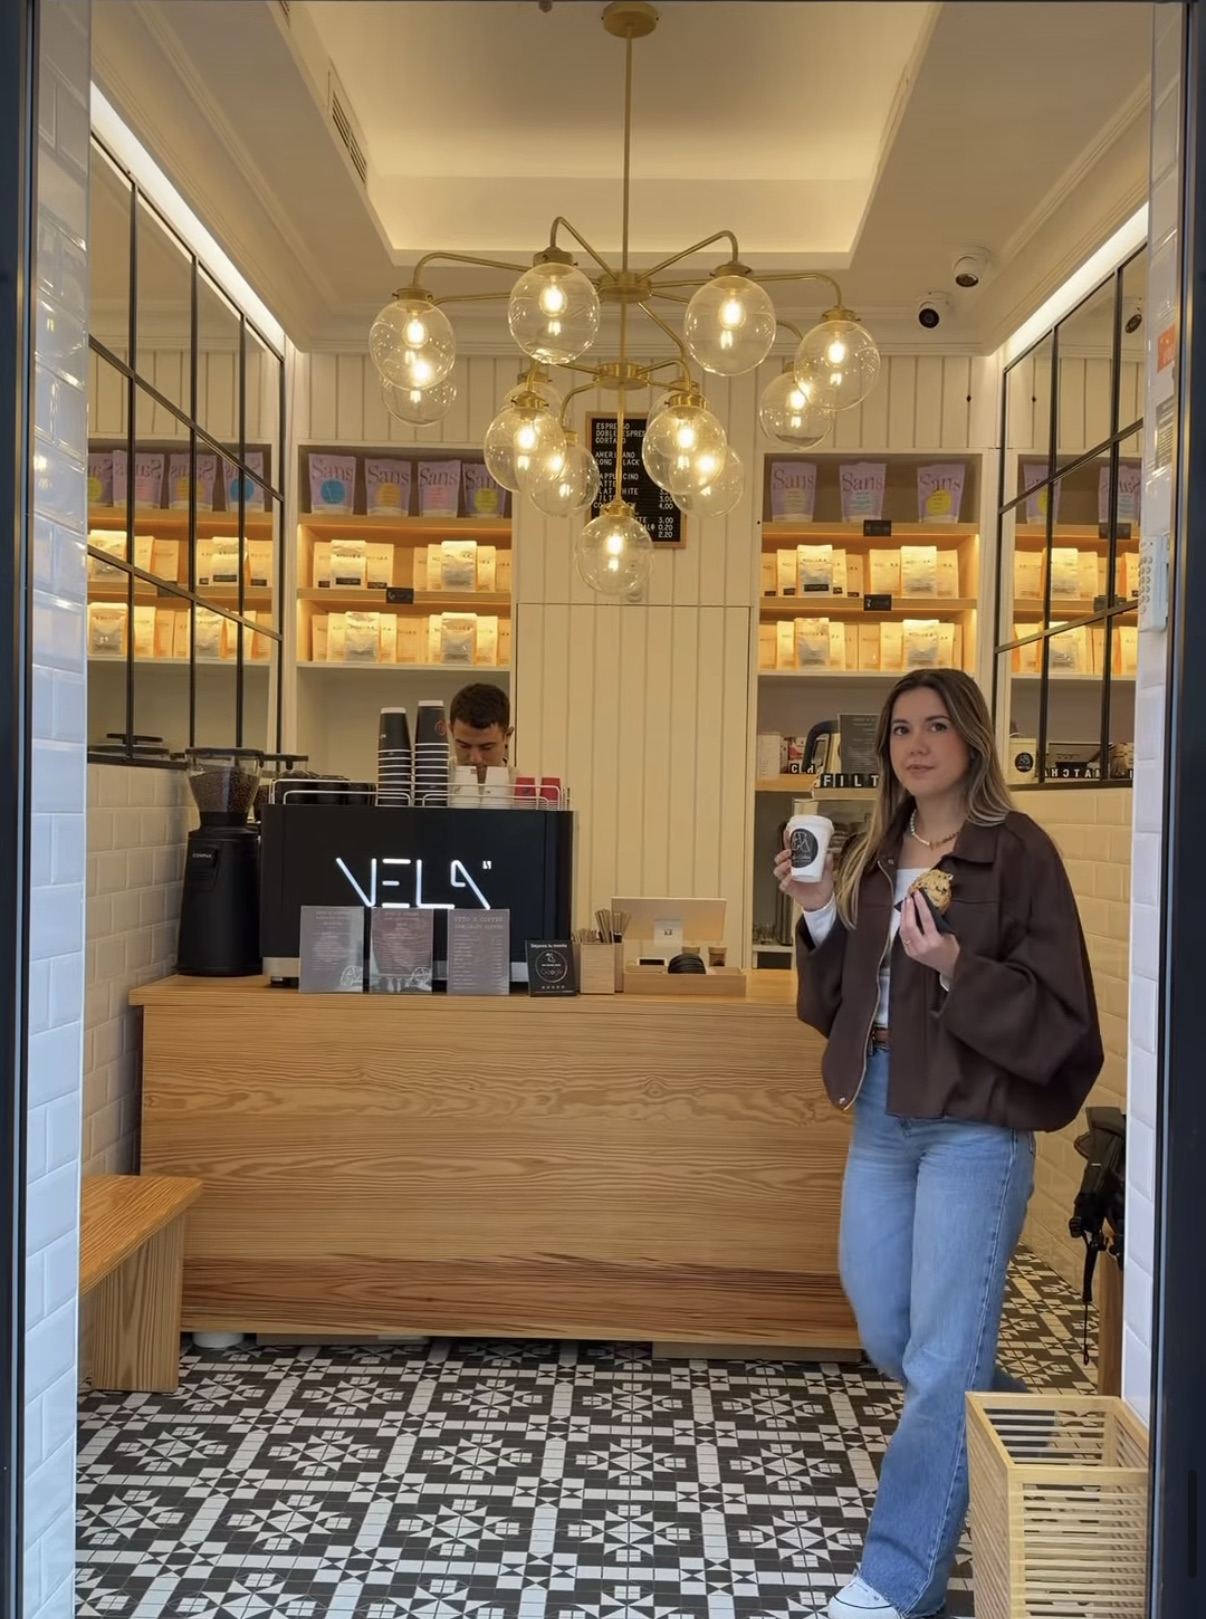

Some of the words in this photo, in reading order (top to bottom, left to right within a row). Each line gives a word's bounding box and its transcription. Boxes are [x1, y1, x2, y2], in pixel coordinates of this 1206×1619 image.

[311, 459, 353, 482] Sans
[368, 465, 410, 485] Sans
[420, 467, 458, 487] Sans
[773, 468, 814, 490] Sans
[842, 471, 883, 493] Sans
[919, 474, 961, 491] Sans
